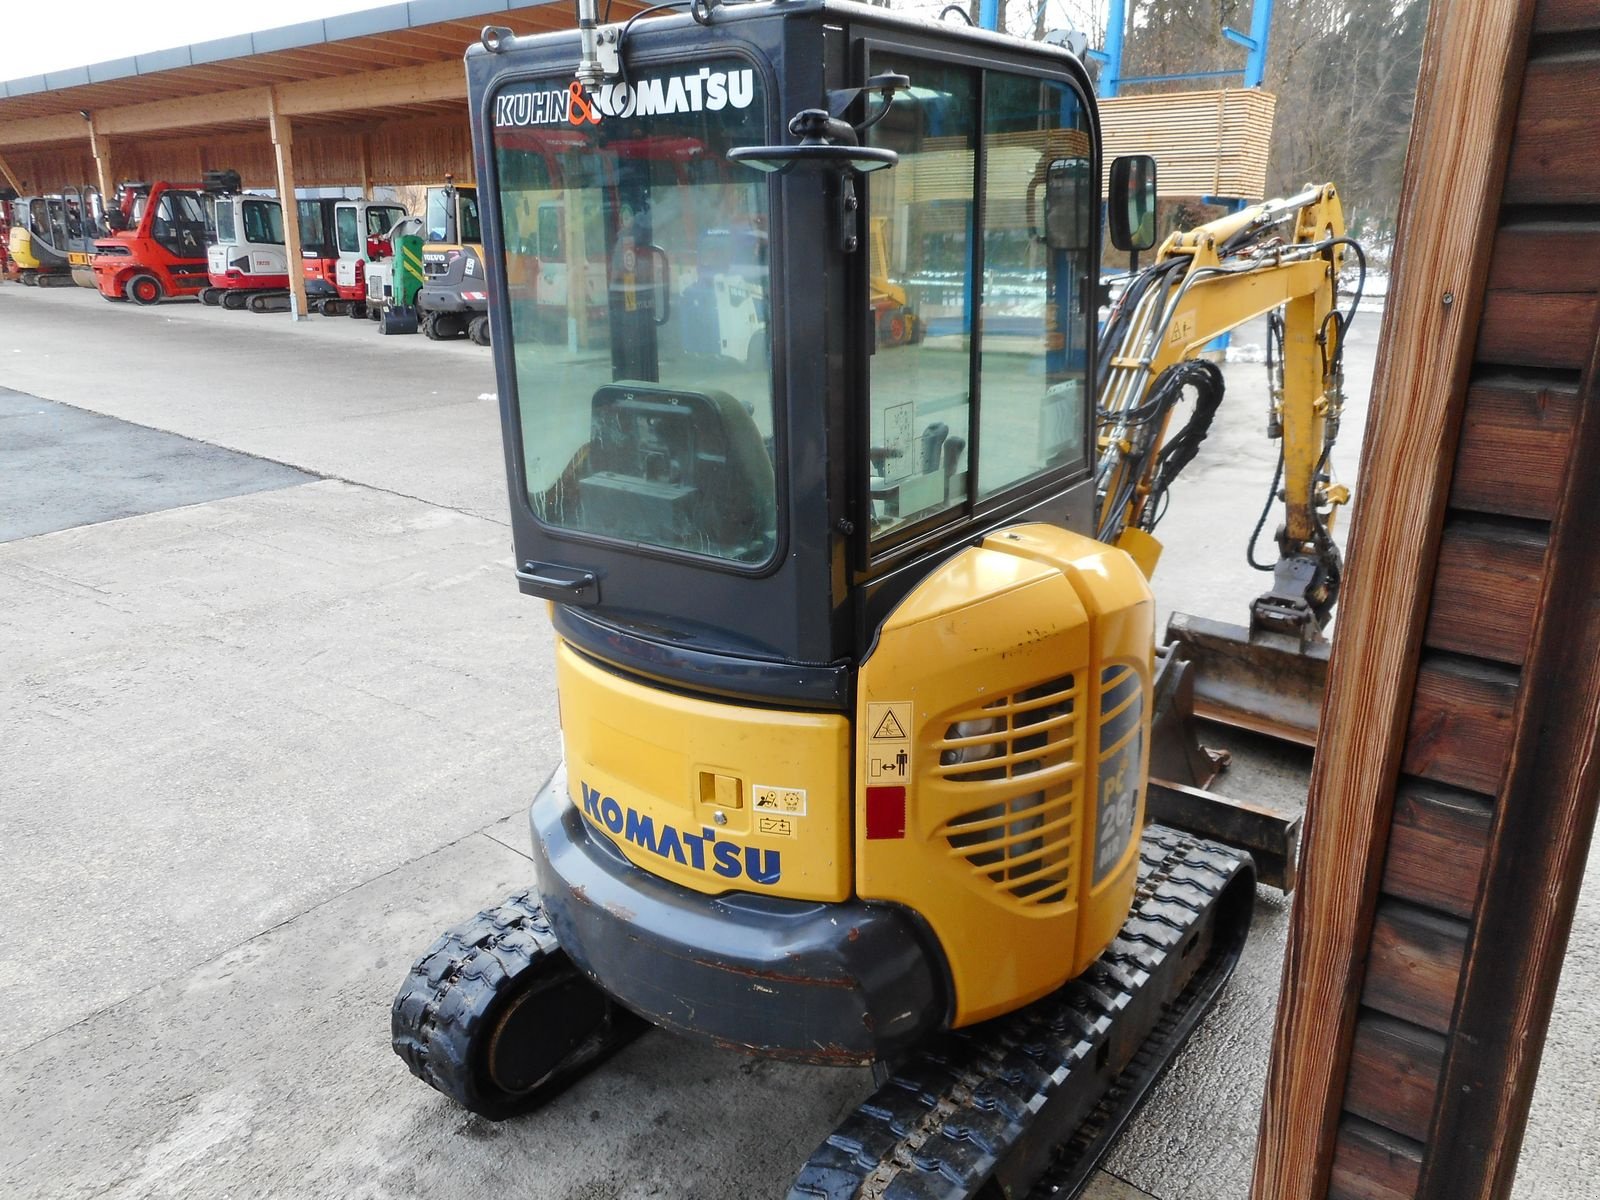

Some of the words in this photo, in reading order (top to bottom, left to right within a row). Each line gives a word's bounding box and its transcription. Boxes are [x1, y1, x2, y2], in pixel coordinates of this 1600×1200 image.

[1103, 769, 1125, 806] PC
[581, 781, 781, 885] KOMATSU
[1100, 792, 1129, 844] 26
